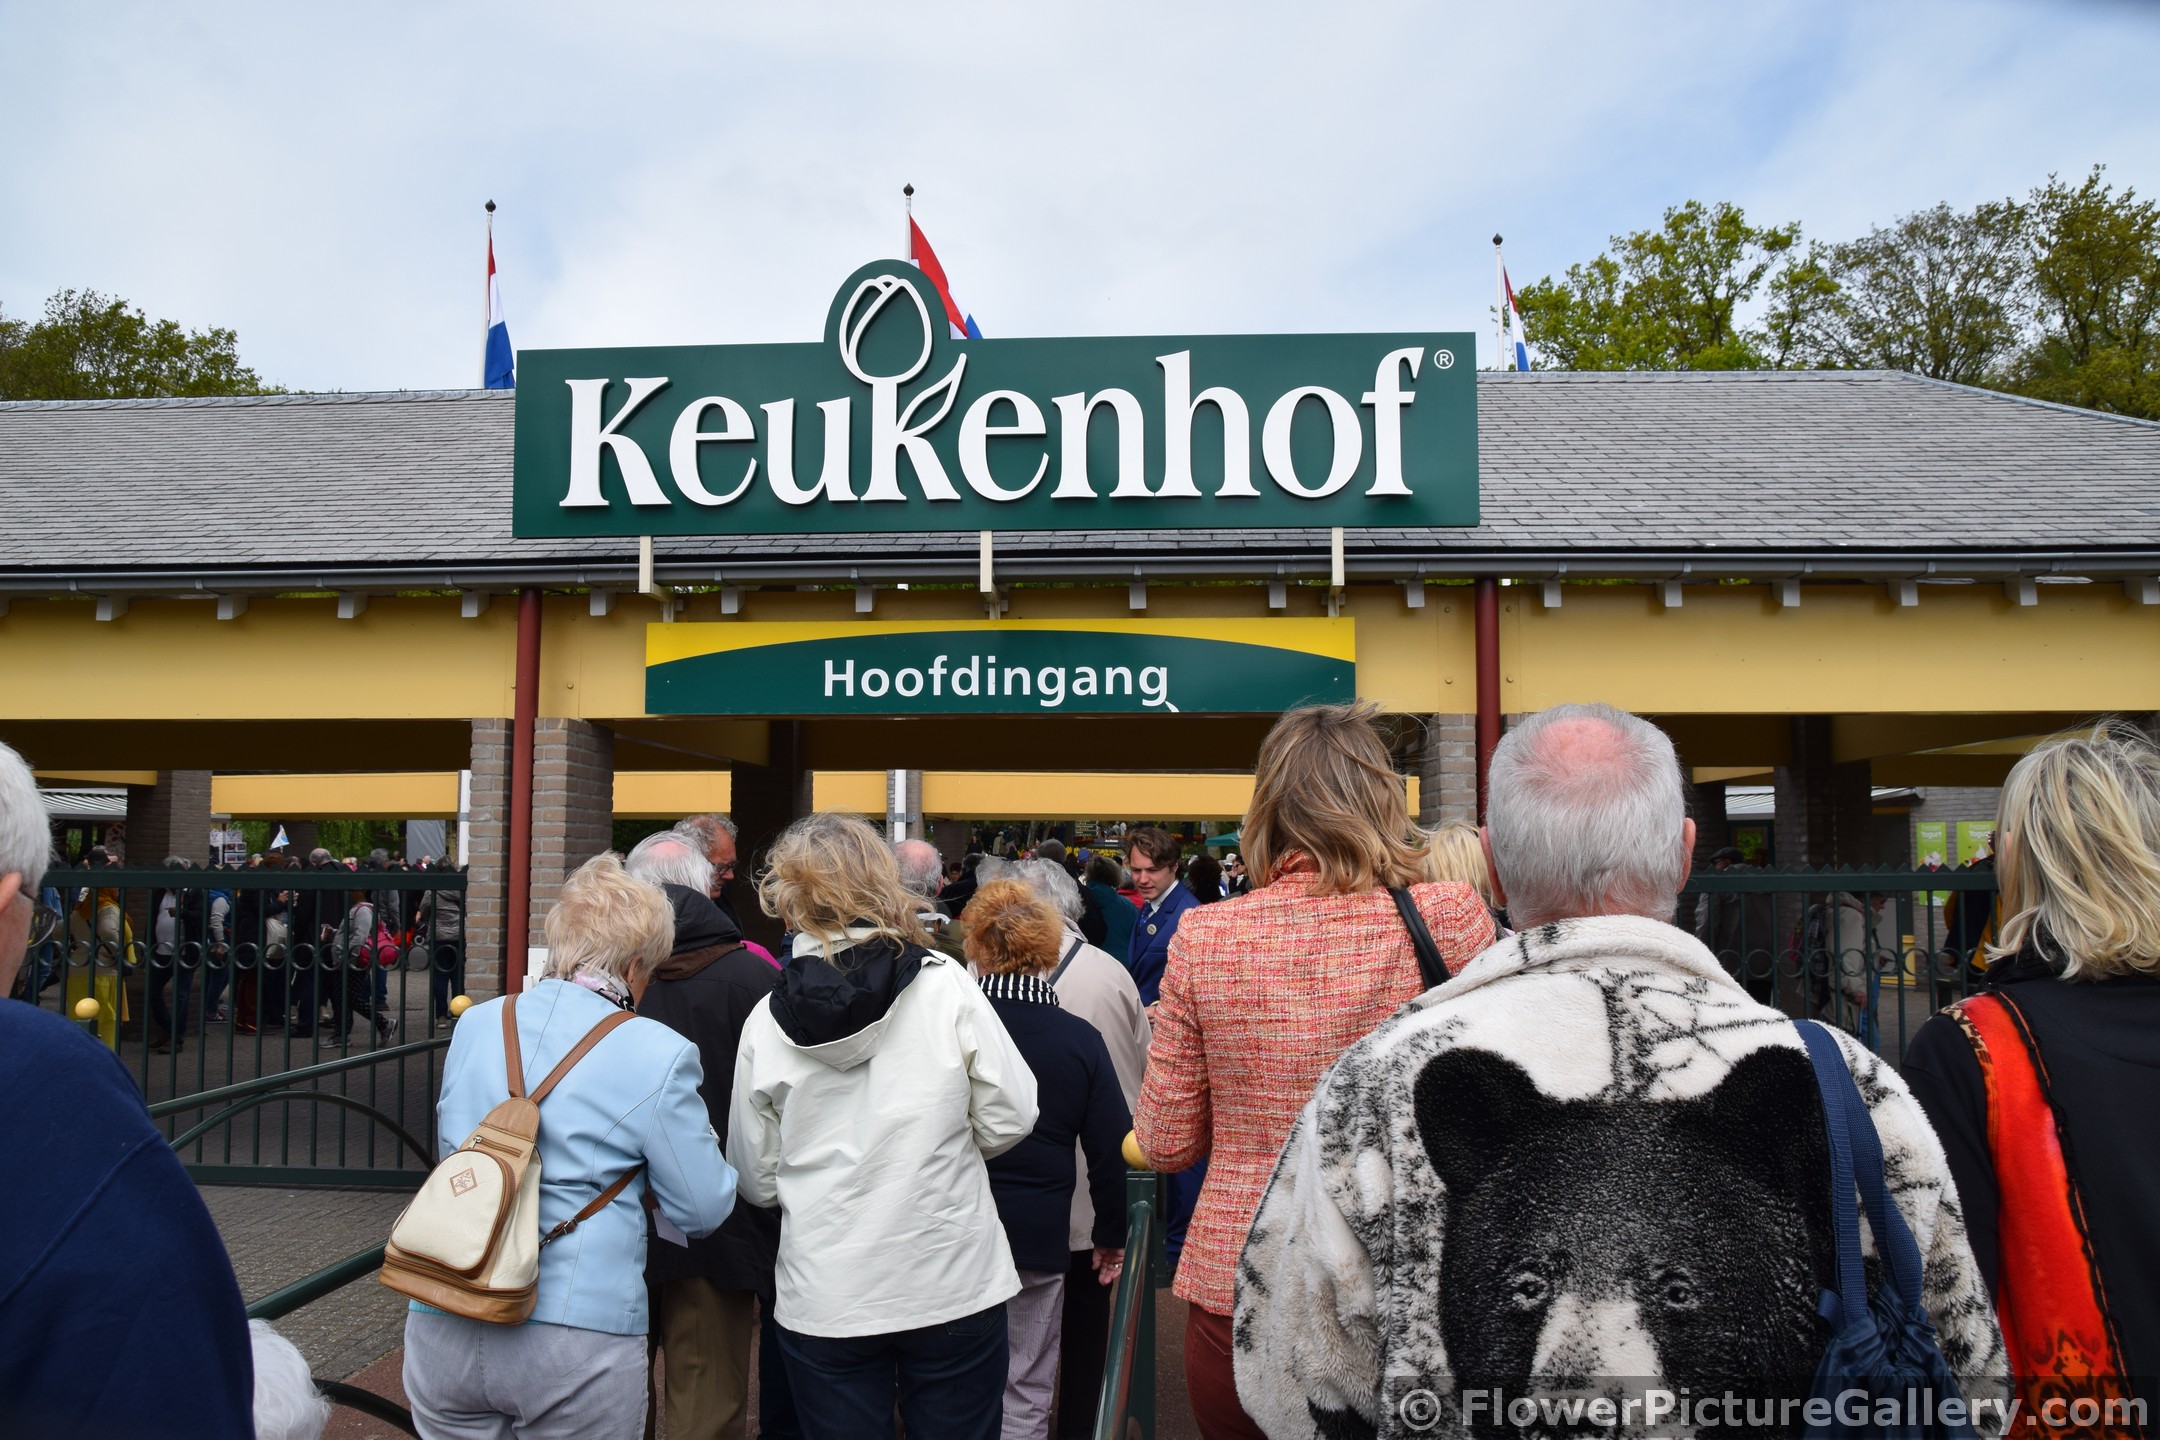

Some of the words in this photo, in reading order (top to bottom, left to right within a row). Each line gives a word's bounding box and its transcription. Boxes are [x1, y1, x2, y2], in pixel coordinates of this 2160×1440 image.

[559, 346, 1425, 508] Keukenhof
[824, 655, 1168, 707] Hoofdingang
[1921, 831, 1942, 839] Yogurt
